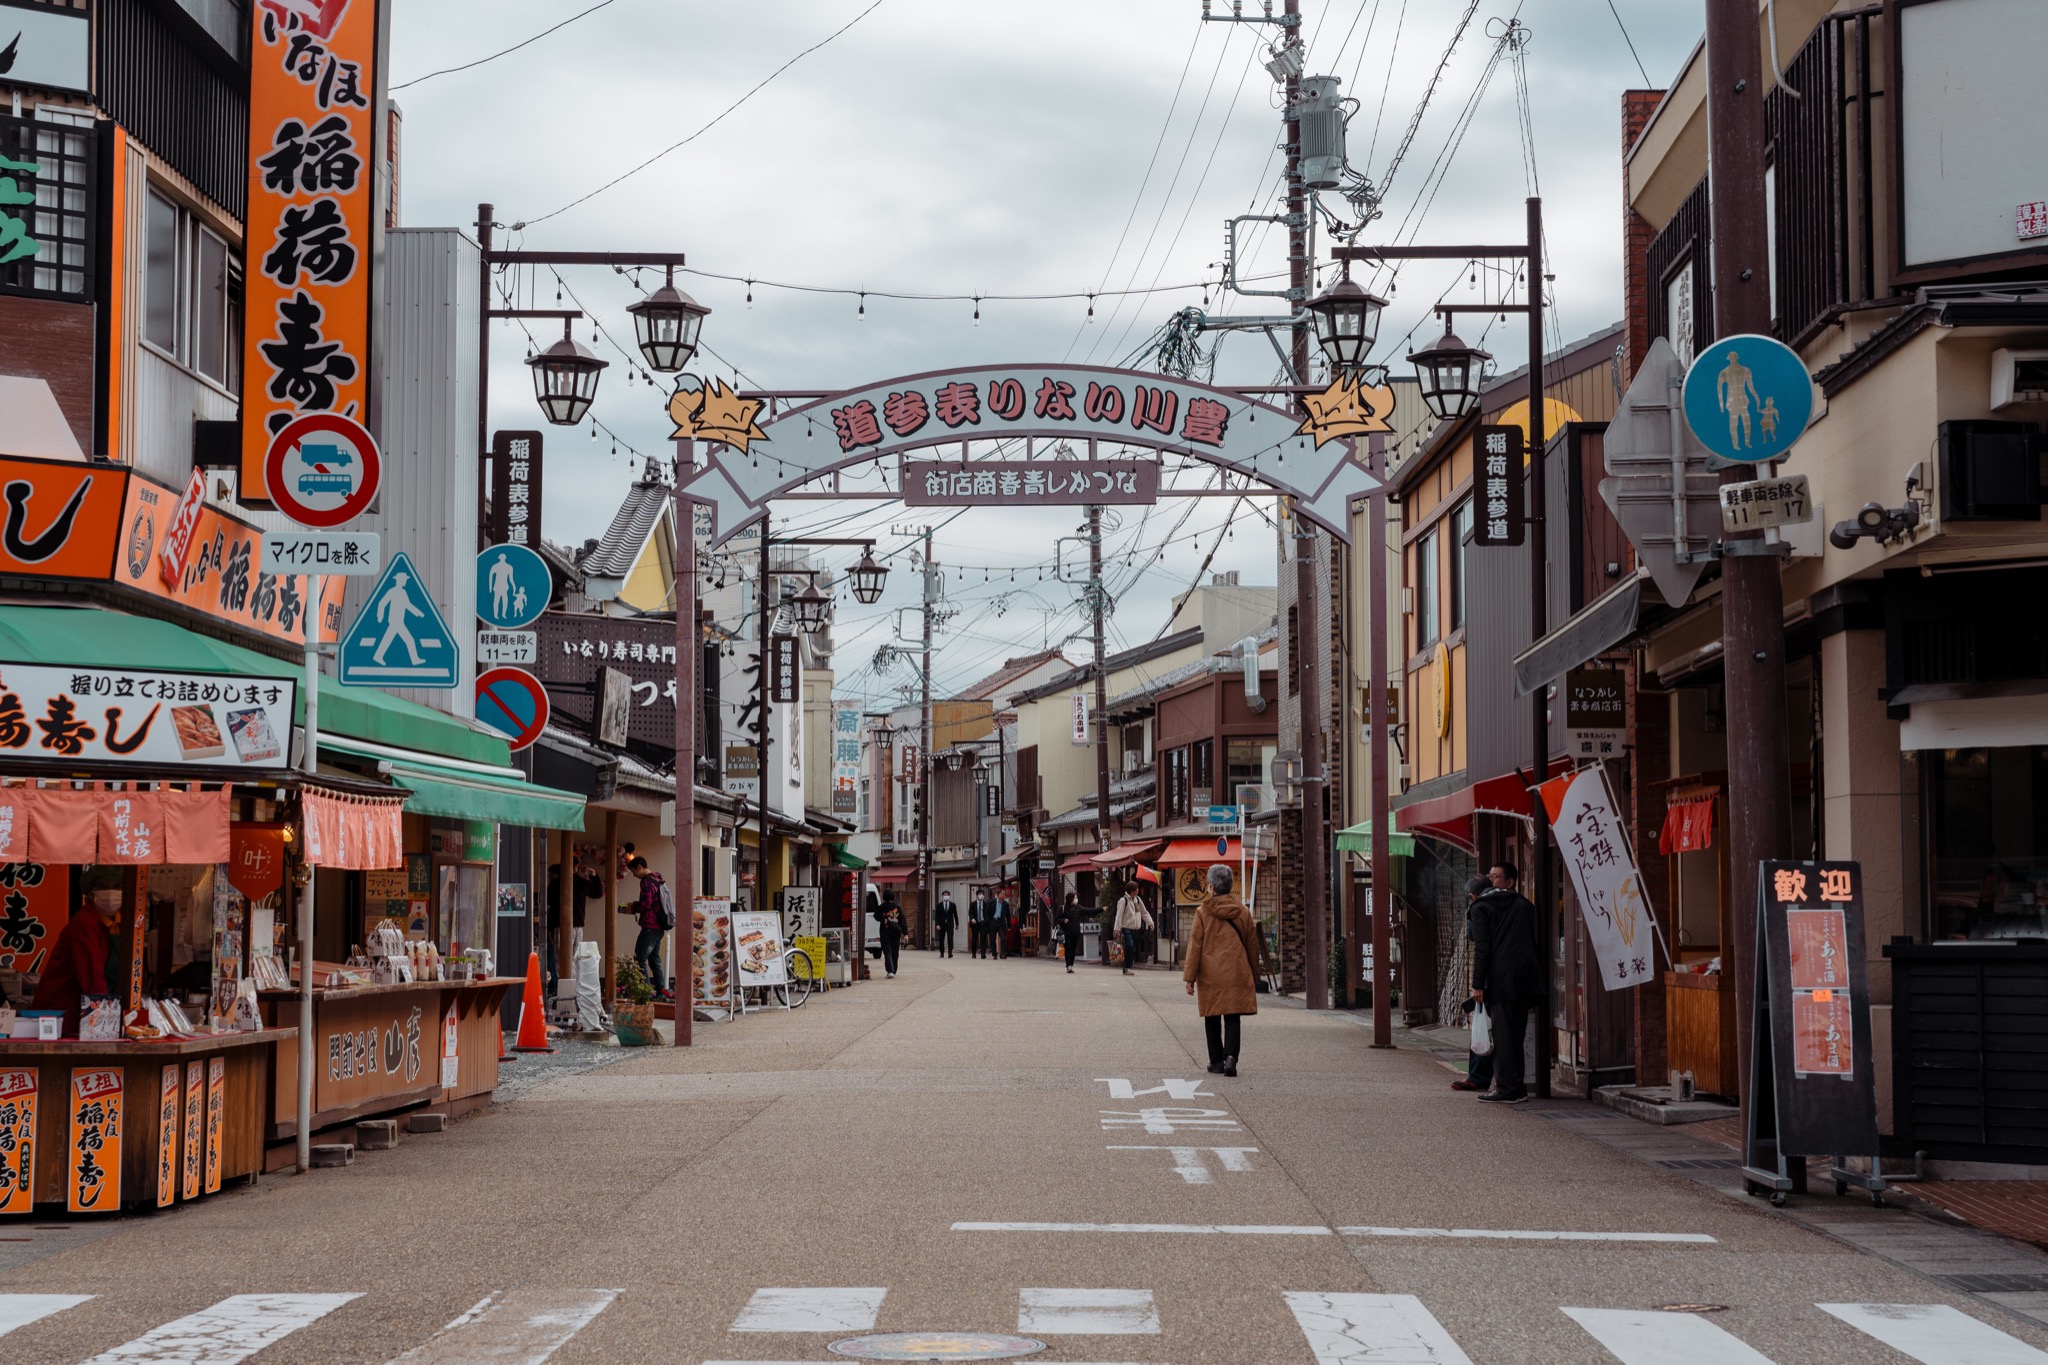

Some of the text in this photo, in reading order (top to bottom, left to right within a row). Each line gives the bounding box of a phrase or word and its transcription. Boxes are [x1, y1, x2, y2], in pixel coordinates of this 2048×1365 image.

[264, 11, 367, 108] いなほ
[508, 439, 530, 545] 稲荷表参道
[1486, 433, 1508, 539] 稲荷表参道
[1726, 483, 1806, 506] 軽車両を除く
[270, 540, 370, 565] マイクロを除く
[480, 633, 534, 647] 軽車両を除く
[70, 674, 283, 706] 握り立てお詰めします
[779, 640, 792, 700] 稲荷表参道
[1575, 687, 1617, 698] なつかし
[1581, 741, 1612, 753] 喜楽
[113, 799, 131, 856] 門前そば
[133, 822, 151, 859] 山彦
[1576, 802, 1619, 867] 宝珠
[329, 1026, 378, 1082] 門前そば
[384, 1006, 422, 1083] 山彦
[80, 1073, 115, 1093] 元祖
[18, 1099, 33, 1139] いなほ
[104, 1098, 119, 1138] いなほ
[187, 1094, 197, 1195] 稲荷寿し
[209, 1090, 218, 1189] 稲荷寿し
[77, 1101, 105, 1208] 稲荷寿し
[162, 1099, 171, 1202] 稲荷寿し
